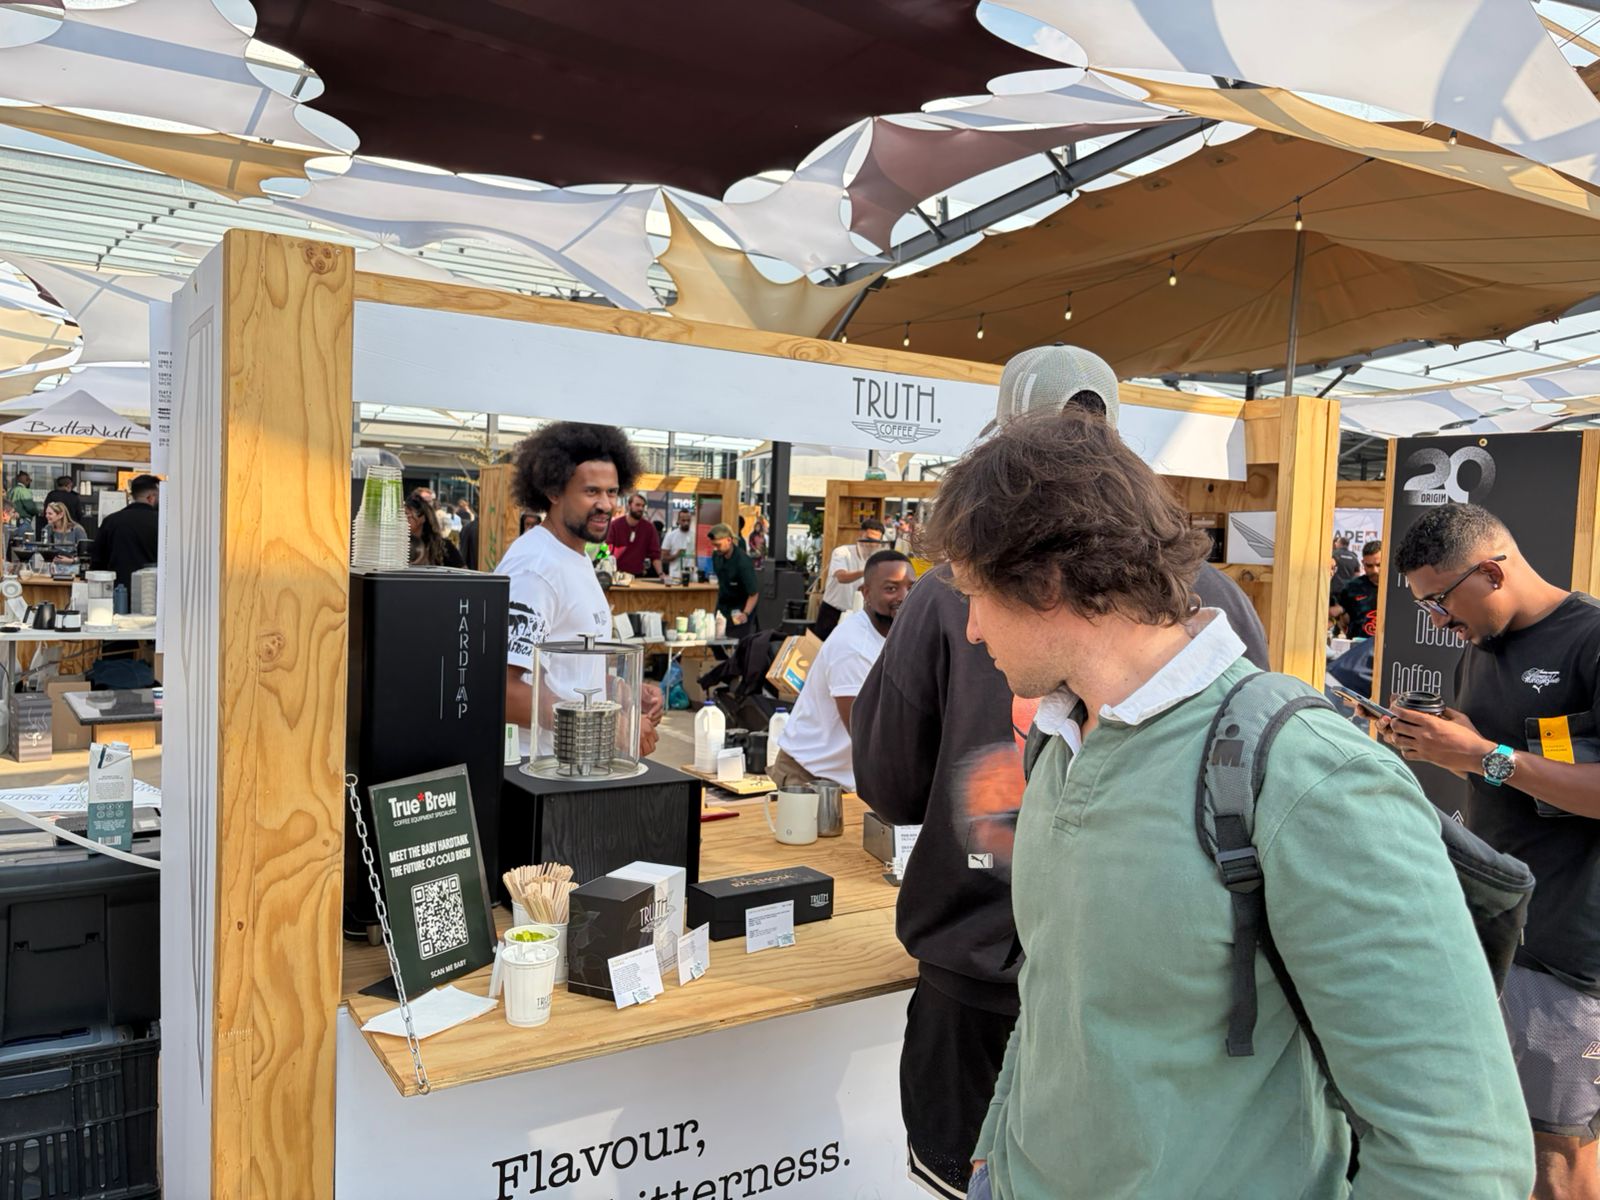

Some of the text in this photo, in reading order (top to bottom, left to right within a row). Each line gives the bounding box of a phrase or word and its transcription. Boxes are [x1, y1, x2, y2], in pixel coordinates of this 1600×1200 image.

[852, 377, 942, 423] TRUTH.
[879, 424, 913, 438] COFFEE
[1421, 494, 1446, 503] ORIGIN
[457, 599, 470, 718] HARDTAP
[388, 791, 456, 818] True Brew
[393, 818, 410, 827] COFFEE
[411, 812, 435, 824] EQUIPMENT
[389, 833, 469, 864] MEET THE BABY HARDTANK
[390, 847, 471, 878] THE FUTURE OF COLD BREW
[430, 959, 467, 979] SCAN ME BABY
[492, 1119, 706, 1200] Flavour,
